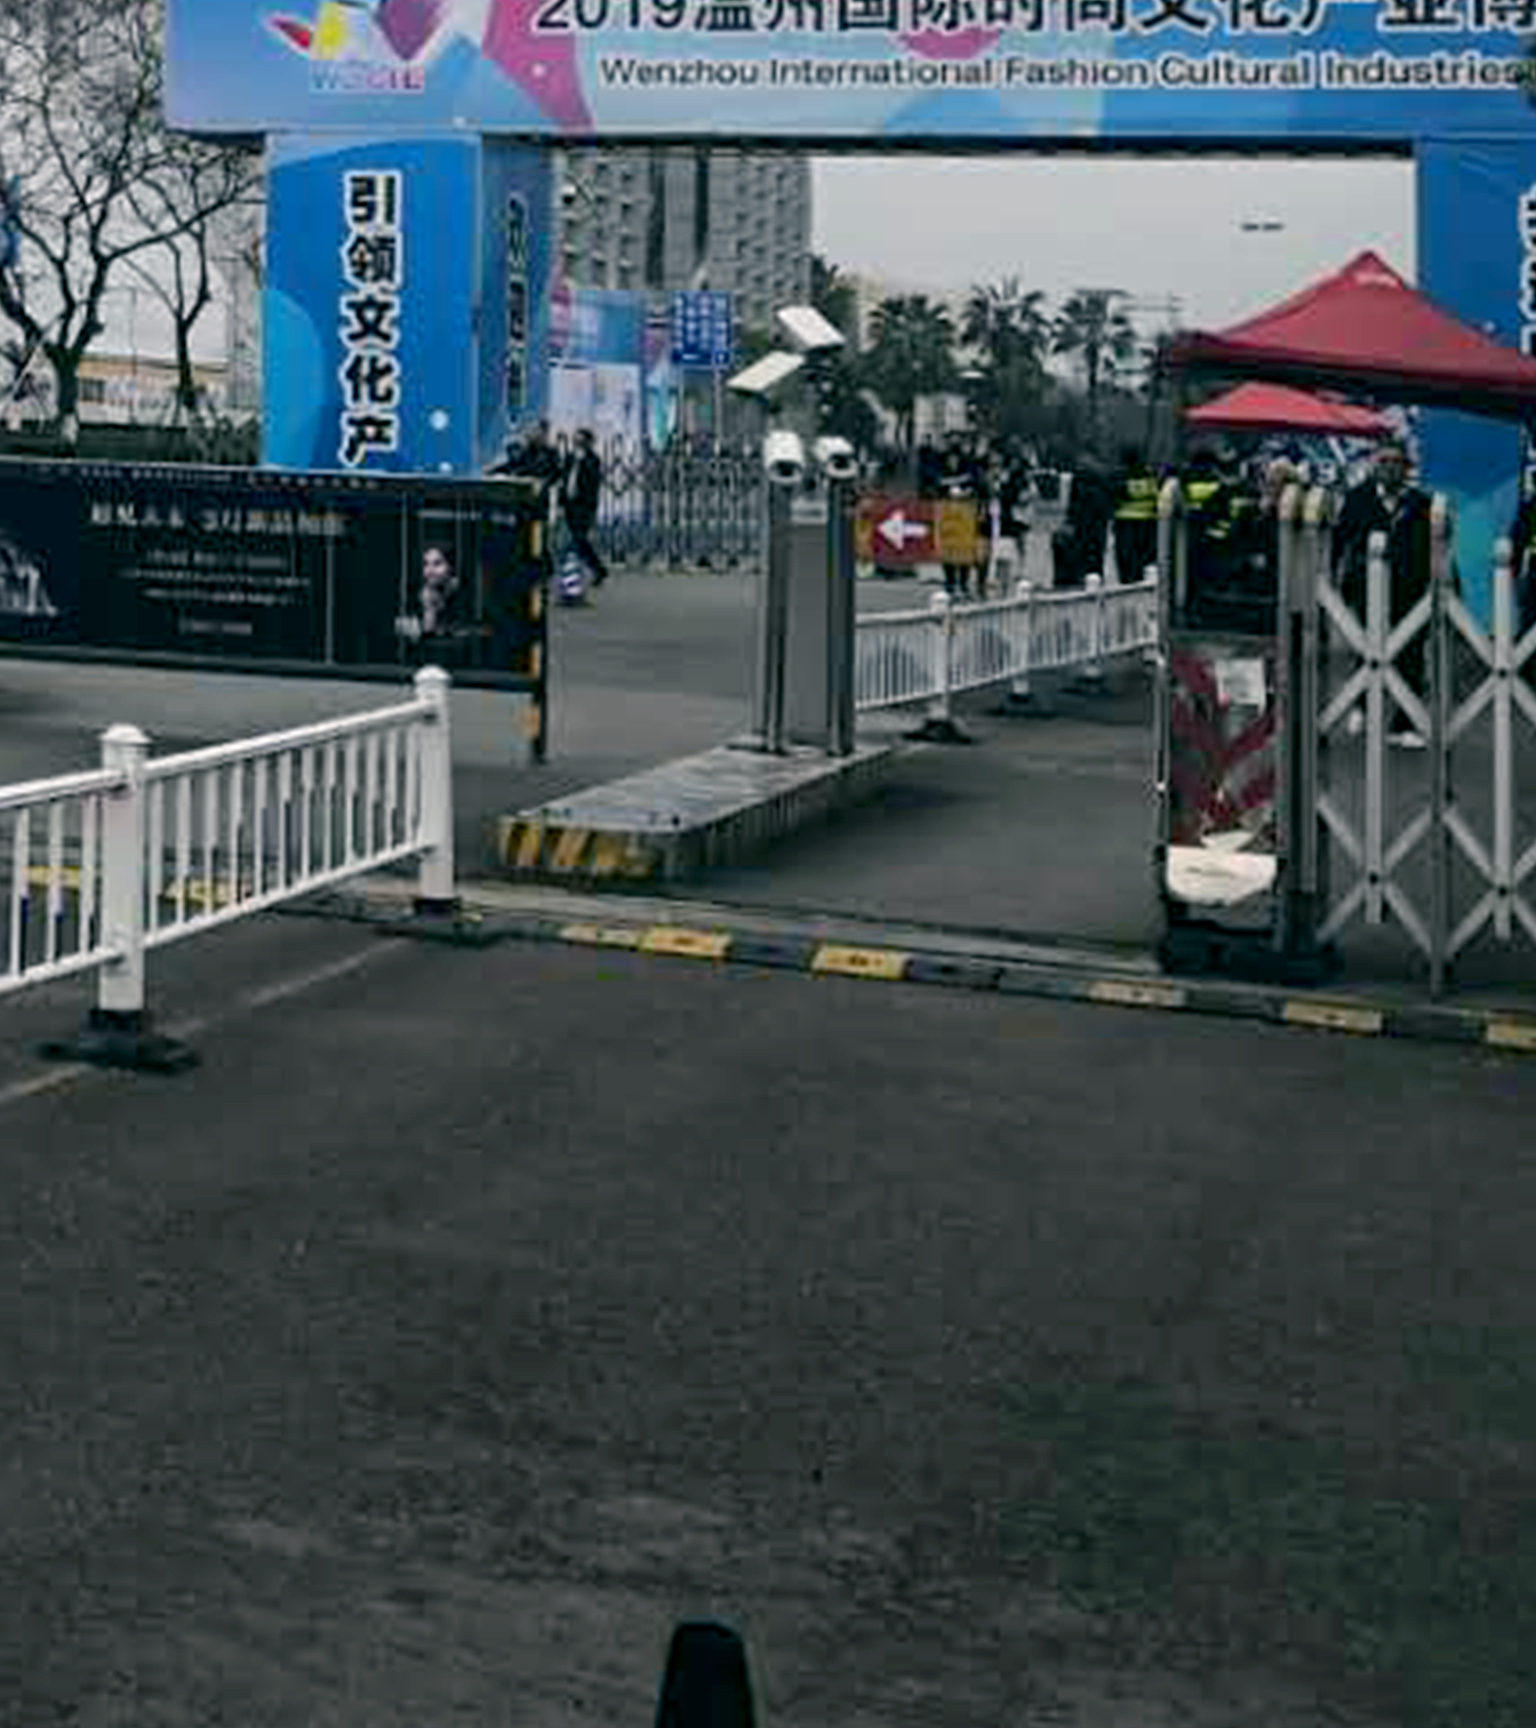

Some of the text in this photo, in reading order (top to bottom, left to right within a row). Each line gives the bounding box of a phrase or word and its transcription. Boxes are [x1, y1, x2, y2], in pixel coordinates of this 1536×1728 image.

[600, 58, 759, 85] Wenzhou
[771, 57, 992, 85] International
[1006, 56, 1146, 84] Fashion
[1159, 55, 1310, 84] Cultural
[343, 173, 399, 465] 引领文化产
